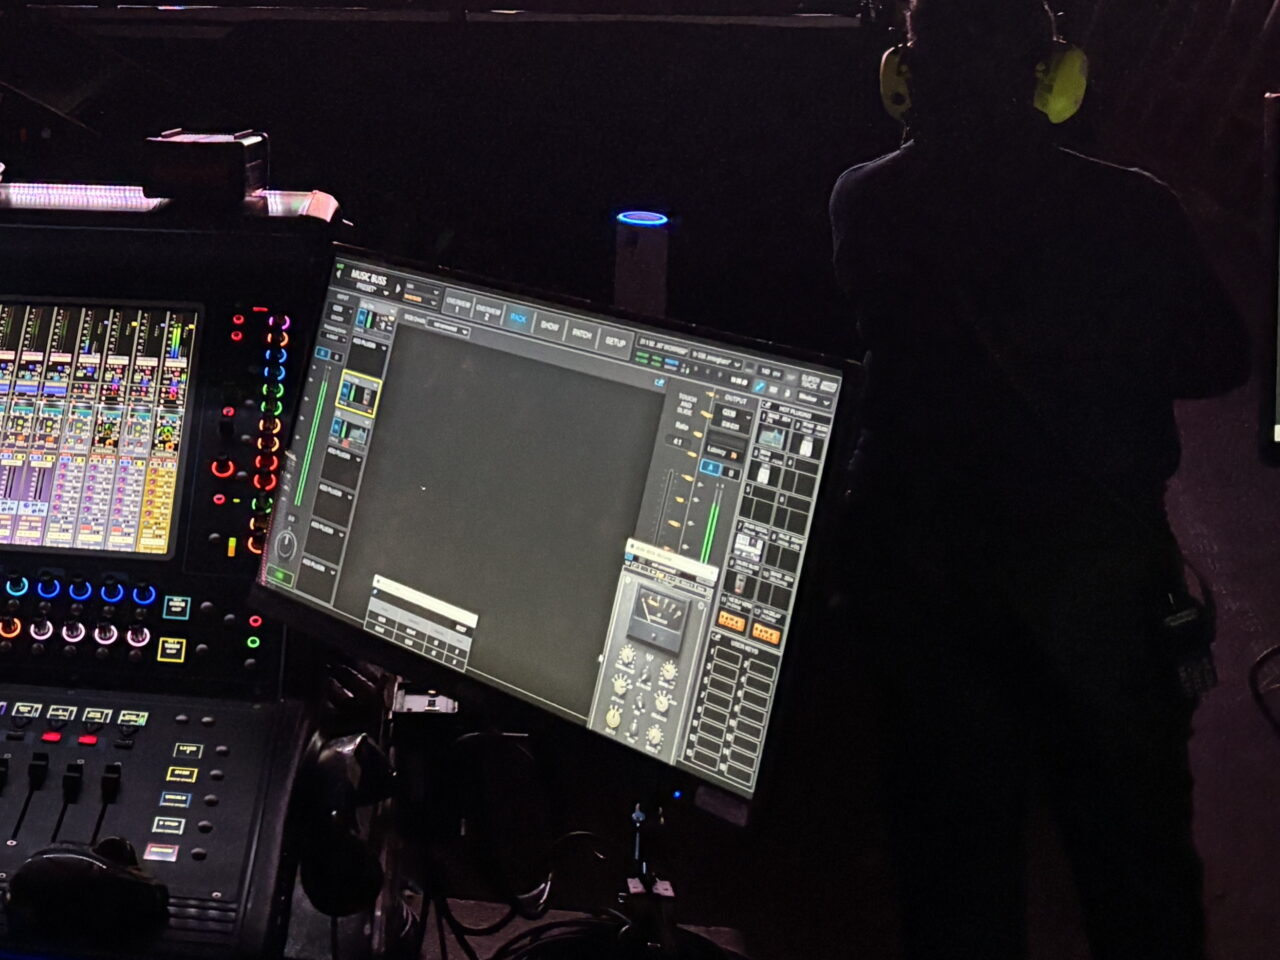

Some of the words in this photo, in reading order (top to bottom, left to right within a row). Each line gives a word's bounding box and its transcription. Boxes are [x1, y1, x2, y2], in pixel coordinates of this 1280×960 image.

[350, 269, 371, 282] MUSIC
[371, 274, 388, 286] BUSS
[510, 312, 528, 324] RACK
[572, 328, 592, 340] PATCH
[605, 336, 626, 348] SETUP
[724, 394, 748, 405] OUTPUT
